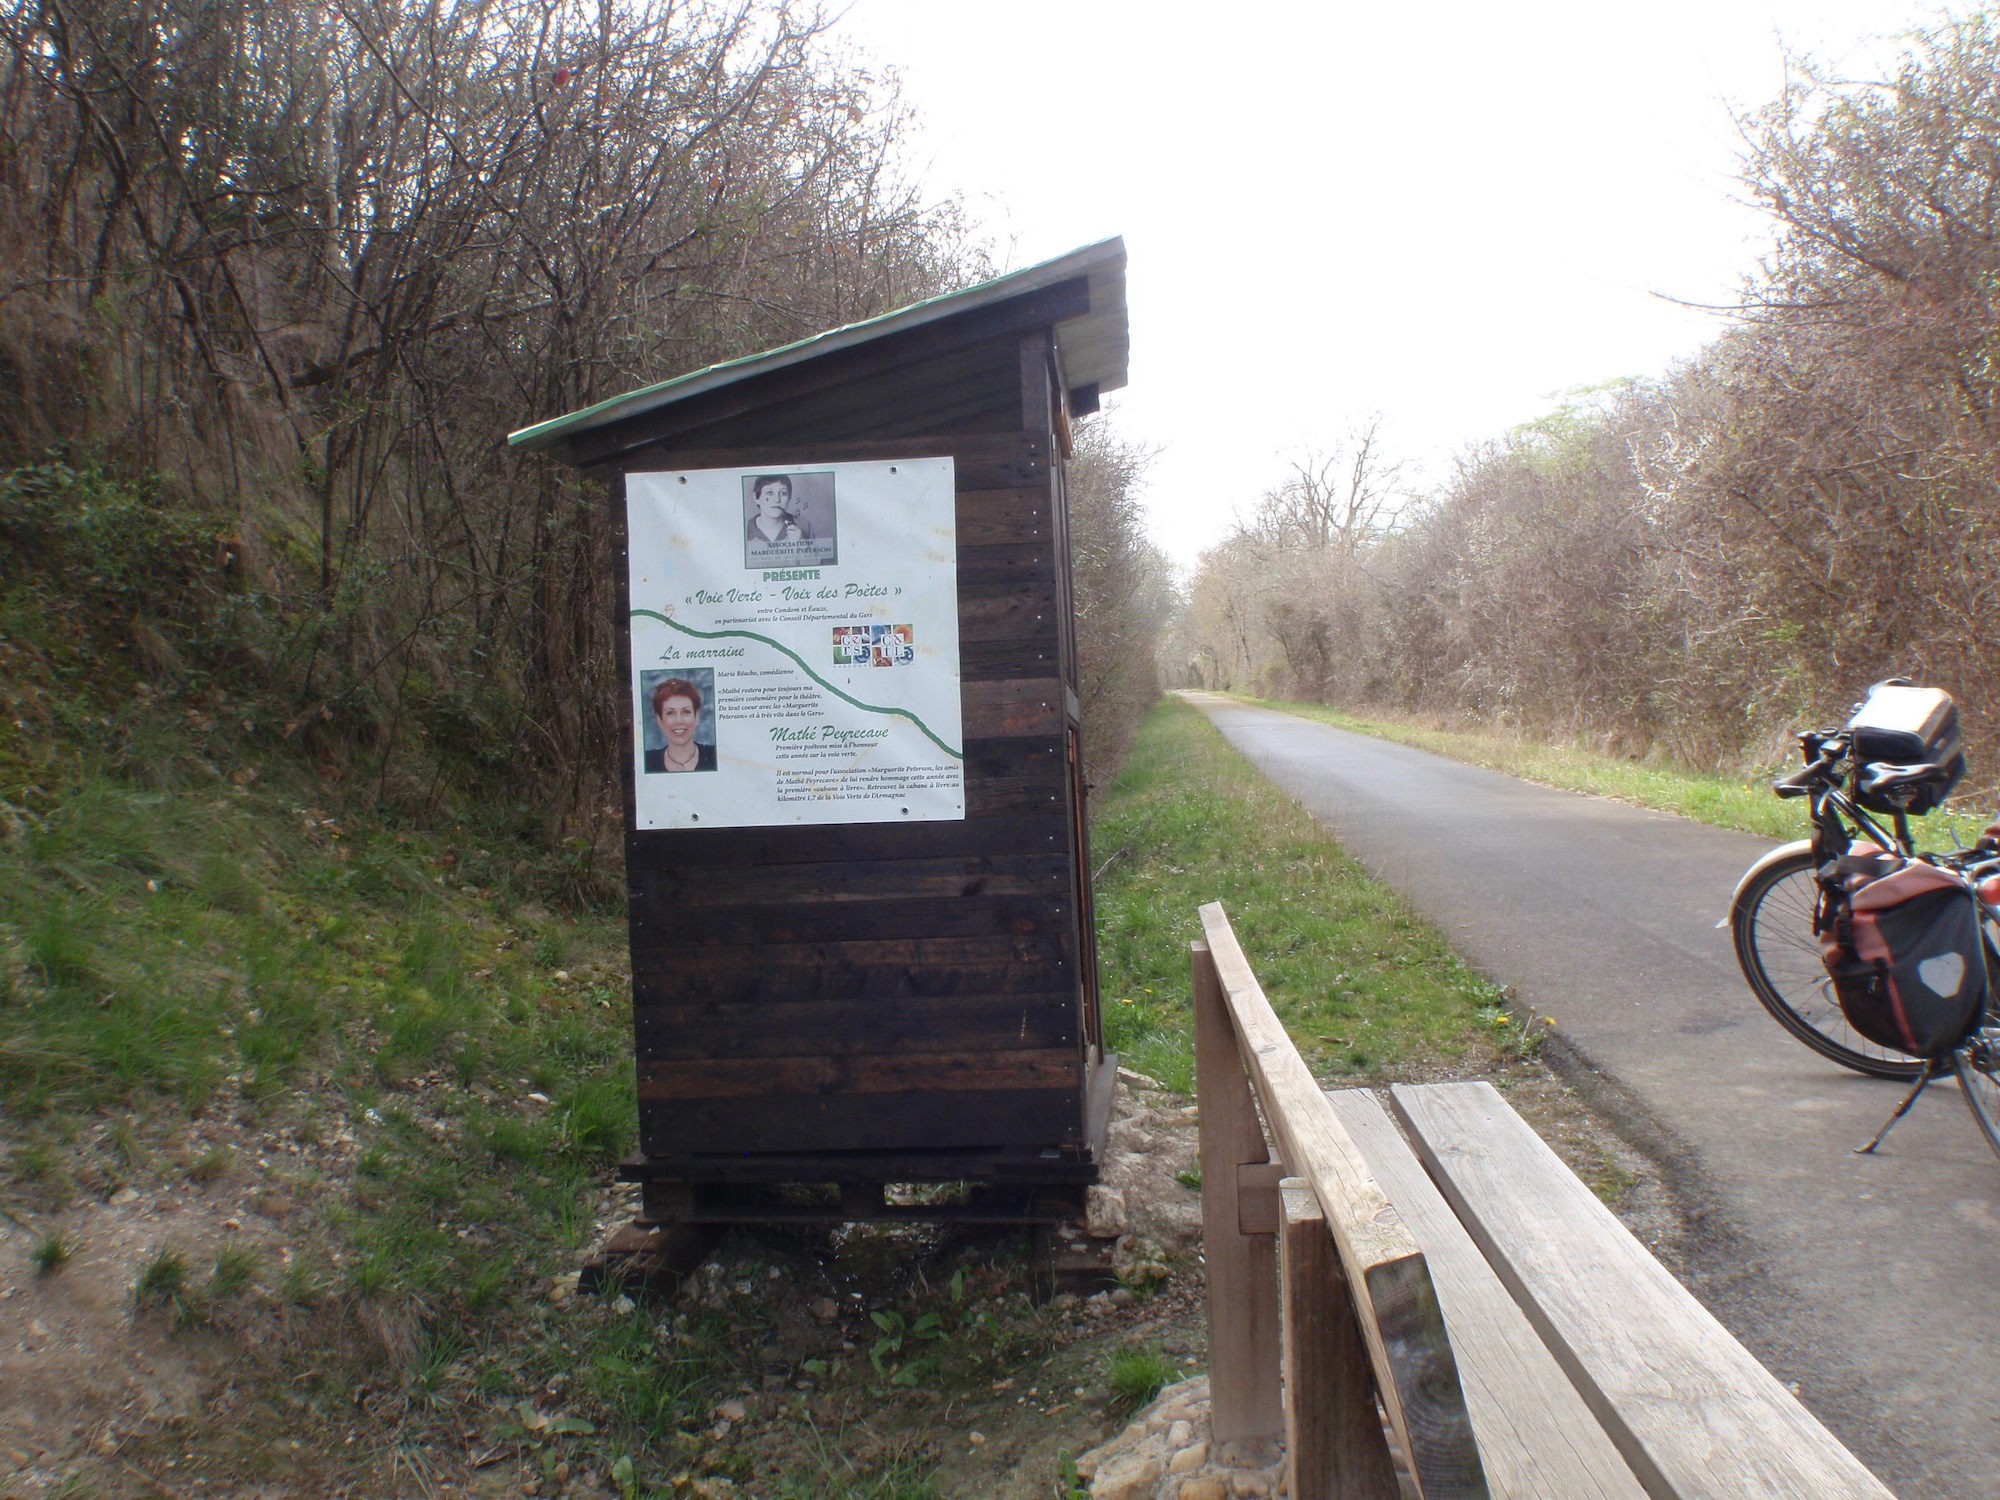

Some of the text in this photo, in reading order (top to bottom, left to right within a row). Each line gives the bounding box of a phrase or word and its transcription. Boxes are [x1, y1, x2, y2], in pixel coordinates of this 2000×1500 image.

[767, 541, 813, 549] ASSOCIATION
[751, 548, 794, 556] MARGUERITE
[763, 569, 821, 582] PRÉSENTE
[695, 589, 724, 605] Voie
[726, 588, 762, 603] Verte
[782, 586, 811, 601] Voix
[816, 586, 838, 599] des
[844, 582, 888, 599] Poètes
[722, 616, 757, 626] partenariat
[803, 613, 848, 622] Départemental
[659, 645, 745, 660] La marraine
[760, 668, 794, 676] comédienne
[718, 696, 744, 704] première
[746, 694, 777, 702] costumière
[769, 725, 889, 743] Mathé Peyrecave
[784, 786, 811, 795] première
[867, 783, 897, 791] Retrouvez
